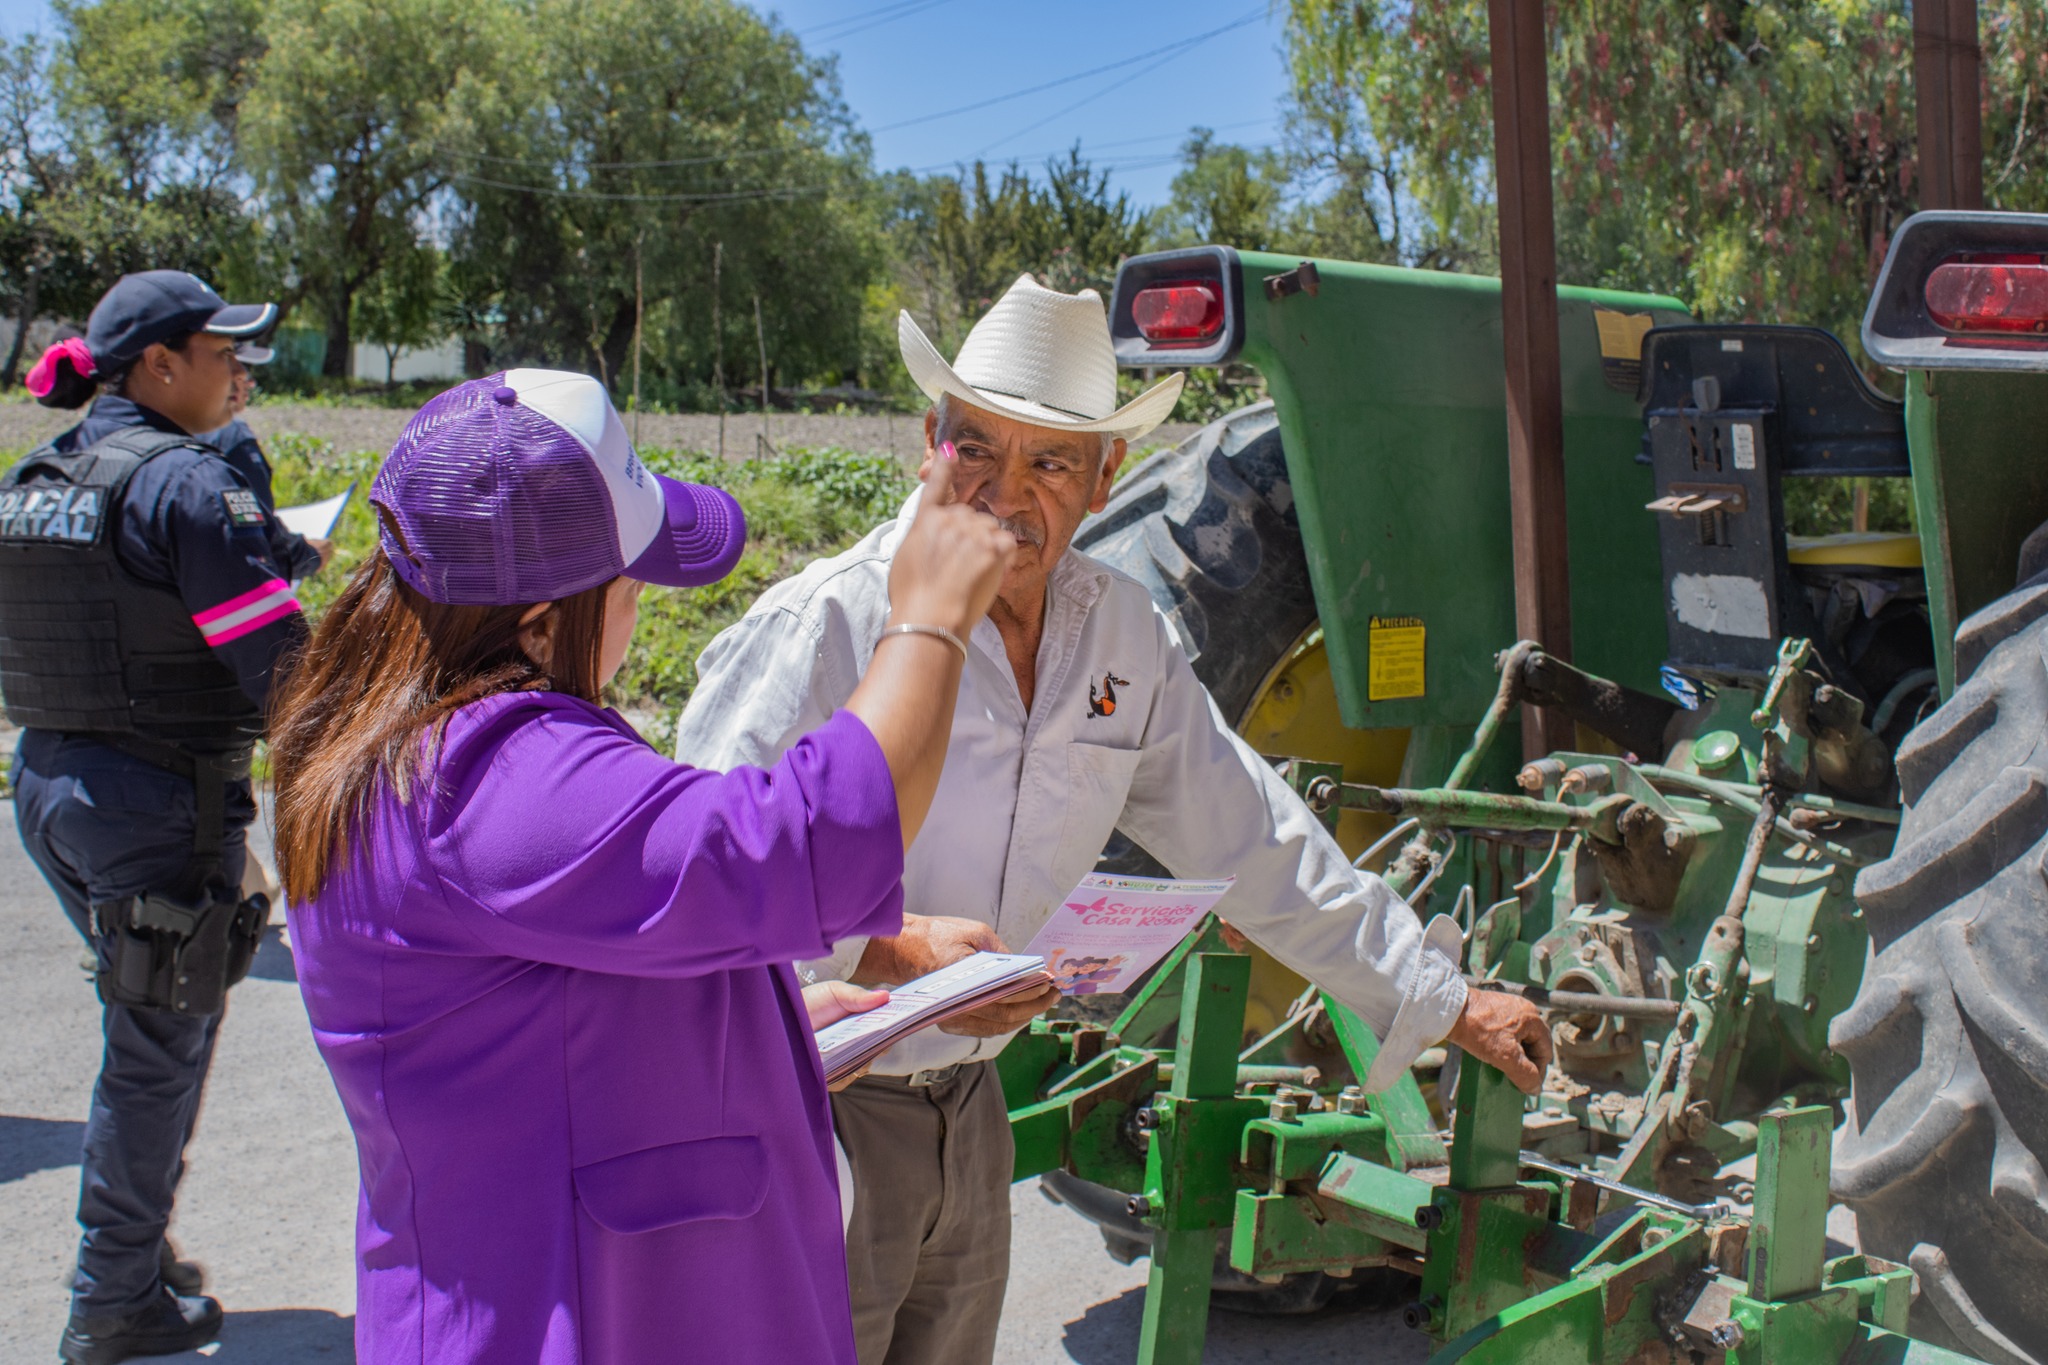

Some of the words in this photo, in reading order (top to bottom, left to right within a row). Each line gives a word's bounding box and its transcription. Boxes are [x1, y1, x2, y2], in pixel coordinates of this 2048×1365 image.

[0, 486, 98, 516] OLICÍA
[1105, 903, 1198, 916] Servicios
[1082, 914, 1132, 926] Casa
[1136, 914, 1187, 927] Rosa
